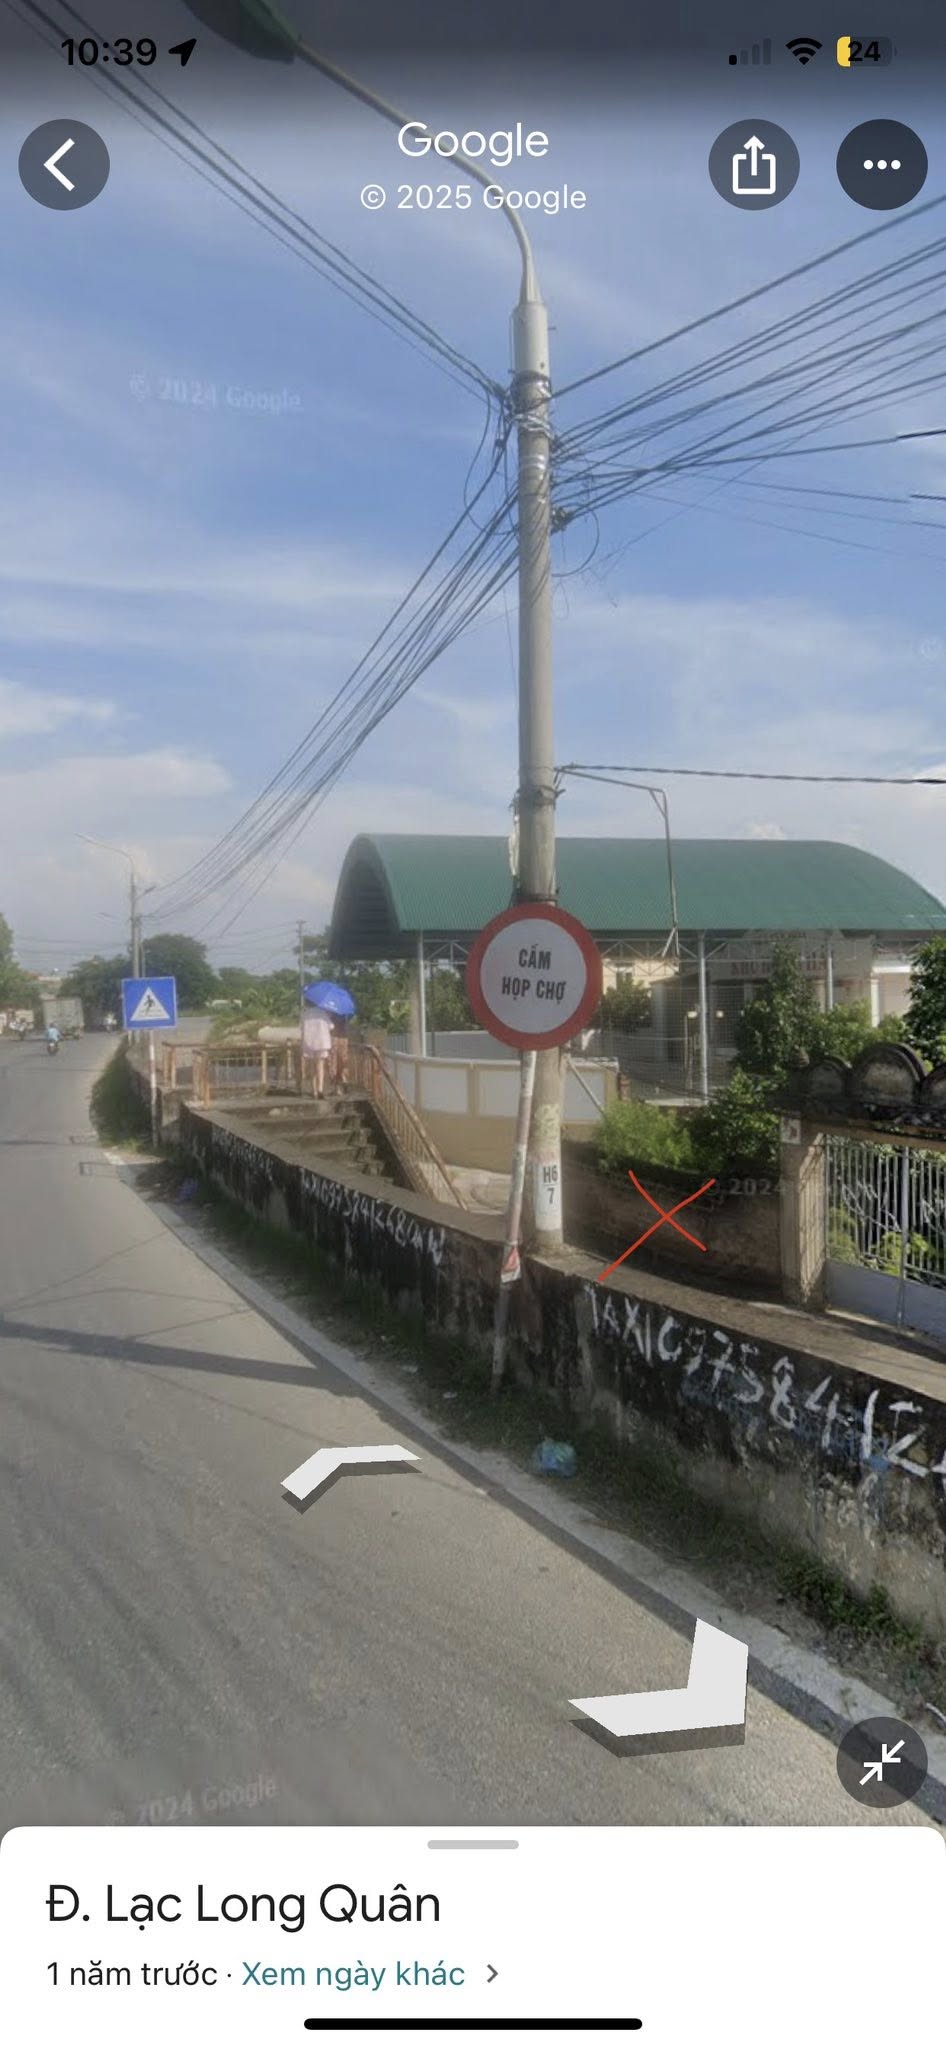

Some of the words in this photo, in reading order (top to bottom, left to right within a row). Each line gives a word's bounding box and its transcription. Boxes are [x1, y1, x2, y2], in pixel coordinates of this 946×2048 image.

[518, 943, 551, 970] CẤM
[501, 975, 530, 1001] HỌP
[536, 979, 566, 1003] CHỢ
[542, 1164, 558, 1184] H6
[547, 1187, 556, 1204] 7
